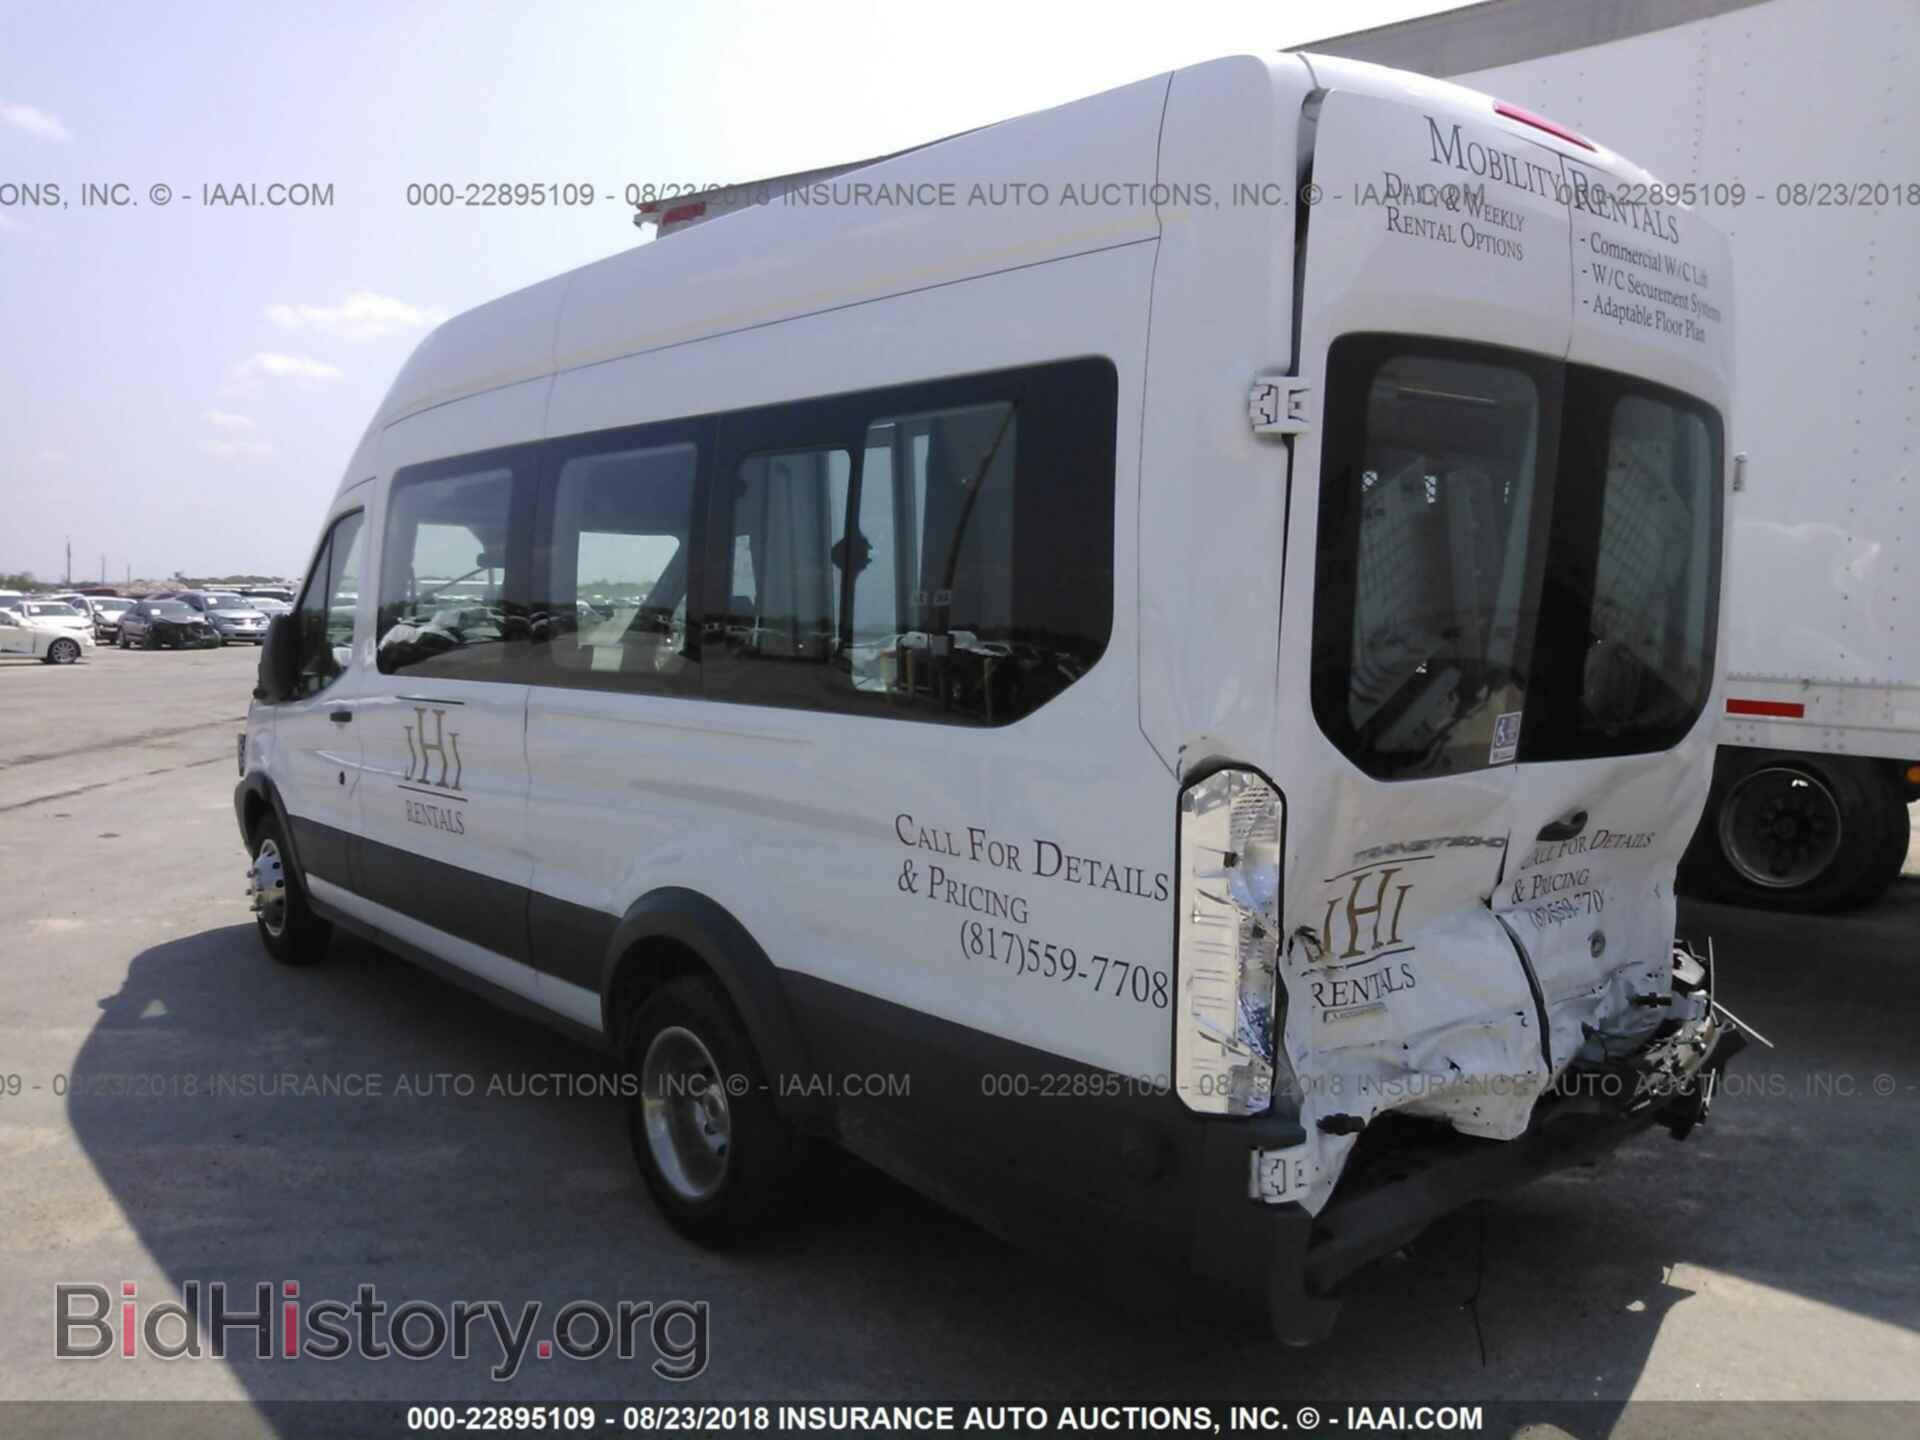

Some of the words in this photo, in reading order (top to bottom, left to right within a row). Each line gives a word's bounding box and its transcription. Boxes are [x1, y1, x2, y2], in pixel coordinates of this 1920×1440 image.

[1424, 115, 1561, 202] MOBILITY
[1386, 206, 1457, 244] RENTAL
[1460, 222, 1524, 261] OPTIONS
[1590, 231, 1661, 272] Commercial
[1591, 263, 1625, 290] W/C
[1627, 273, 1689, 311] Securement
[1592, 296, 1653, 328] Adaptable
[1655, 310, 1683, 337] Floor
[406, 799, 465, 835] RENTALS
[895, 814, 961, 857] CALL
[966, 826, 1023, 872] FOR
[1032, 839, 1169, 902] DETAILS
[897, 858, 919, 895] &
[927, 864, 1029, 925] PRICING
[960, 919, 1169, 1009] (817)559-7708
[1310, 962, 1416, 1008] RENTALS
